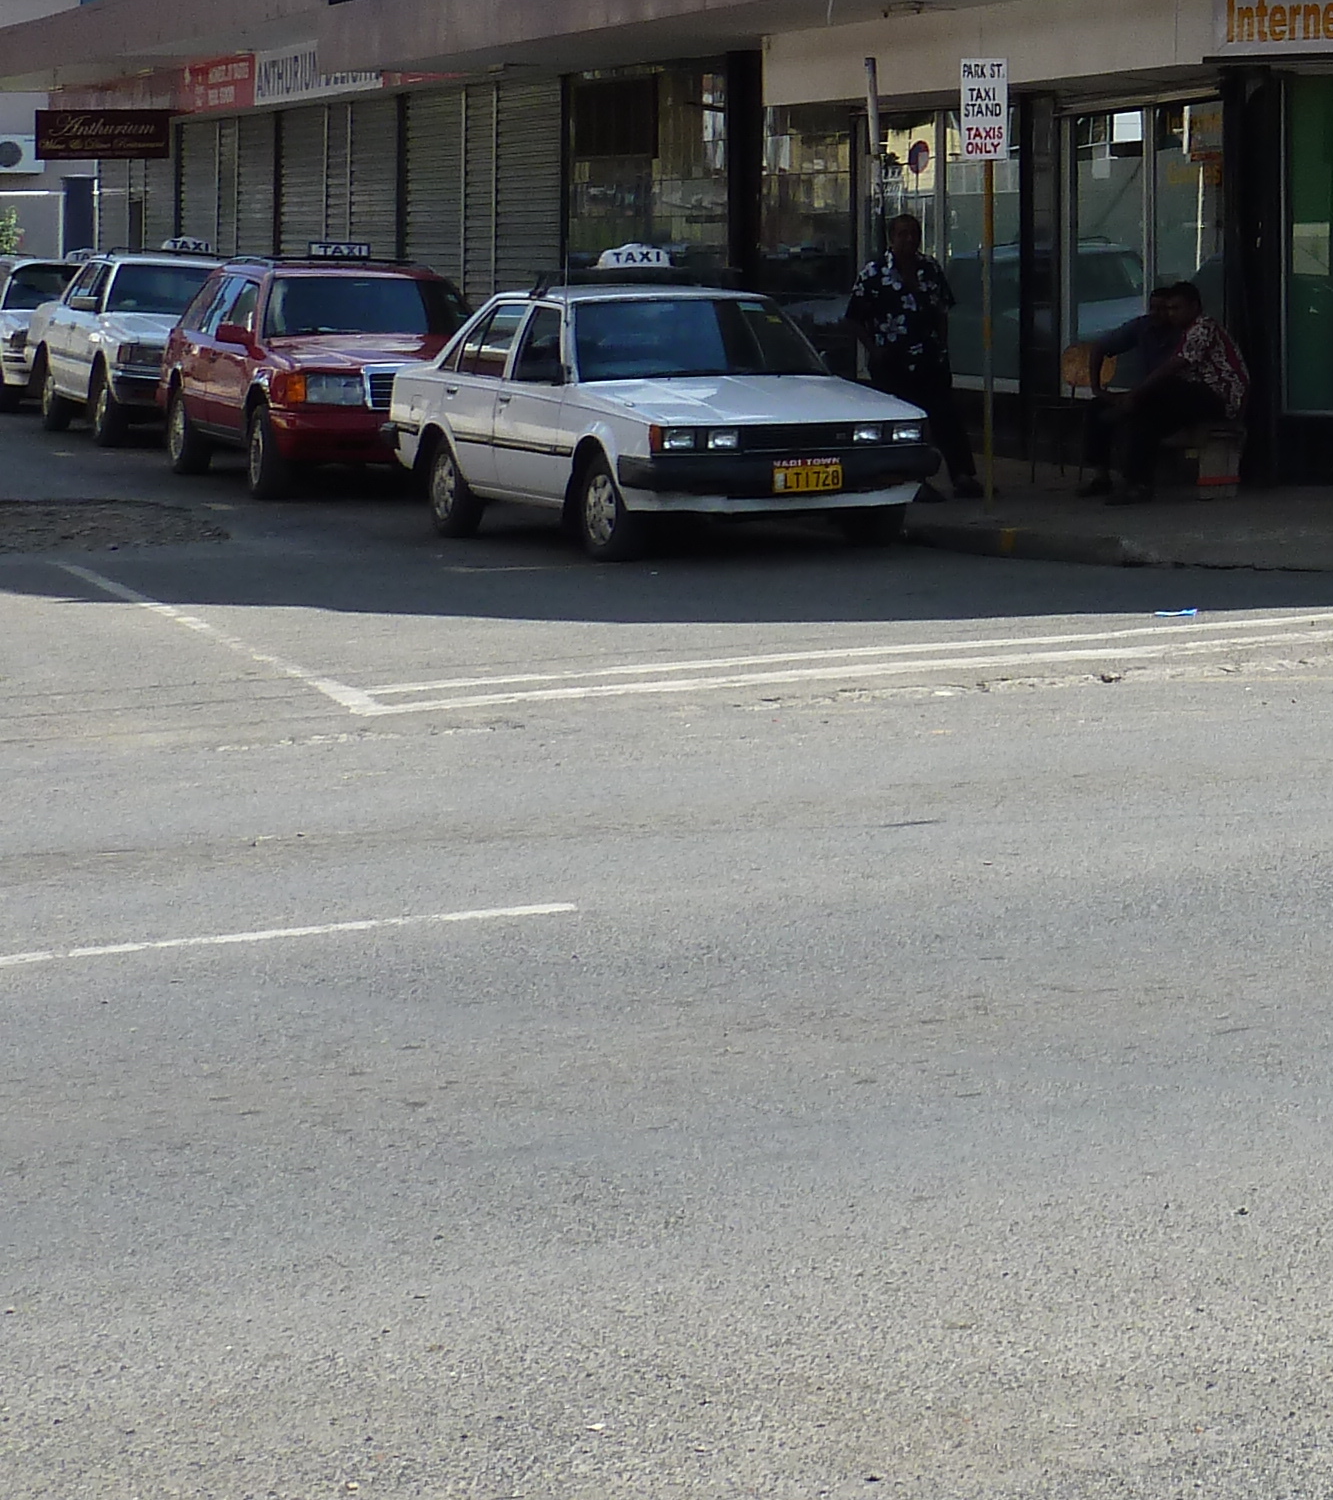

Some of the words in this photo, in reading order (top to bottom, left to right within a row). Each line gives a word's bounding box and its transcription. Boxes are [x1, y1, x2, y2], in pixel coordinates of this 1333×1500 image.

[962, 63, 987, 79] PARK
[990, 63, 1005, 79] ST.
[968, 87, 996, 102] TAXI
[964, 103, 1002, 118] STAND
[48, 112, 156, 137] Anthurium
[966, 126, 1003, 141] TAXIS
[966, 142, 1001, 155] ONLY
[169, 239, 209, 252] TAXI
[318, 245, 363, 256] TAXI
[613, 251, 661, 264] TAXI
